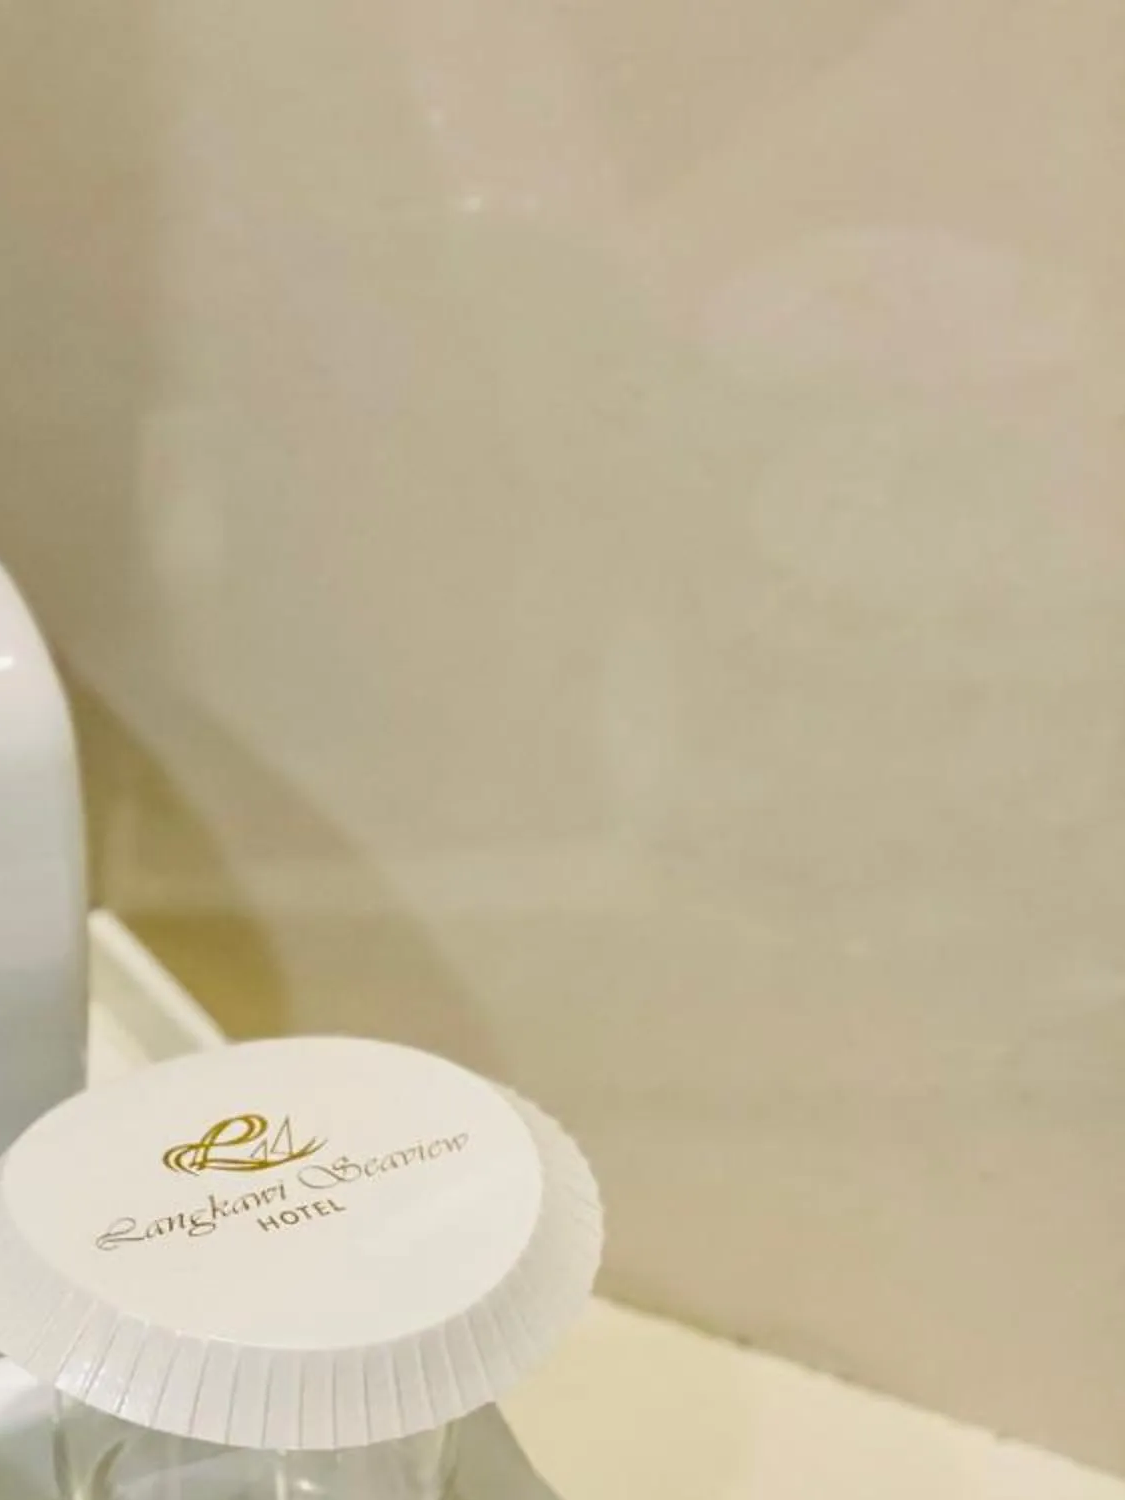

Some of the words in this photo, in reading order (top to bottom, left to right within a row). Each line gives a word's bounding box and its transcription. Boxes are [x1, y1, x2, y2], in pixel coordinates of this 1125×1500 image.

[95, 1180, 286, 1251] Langkawi
[297, 1131, 470, 1190] Seaview
[256, 1198, 347, 1232] HOTEL
